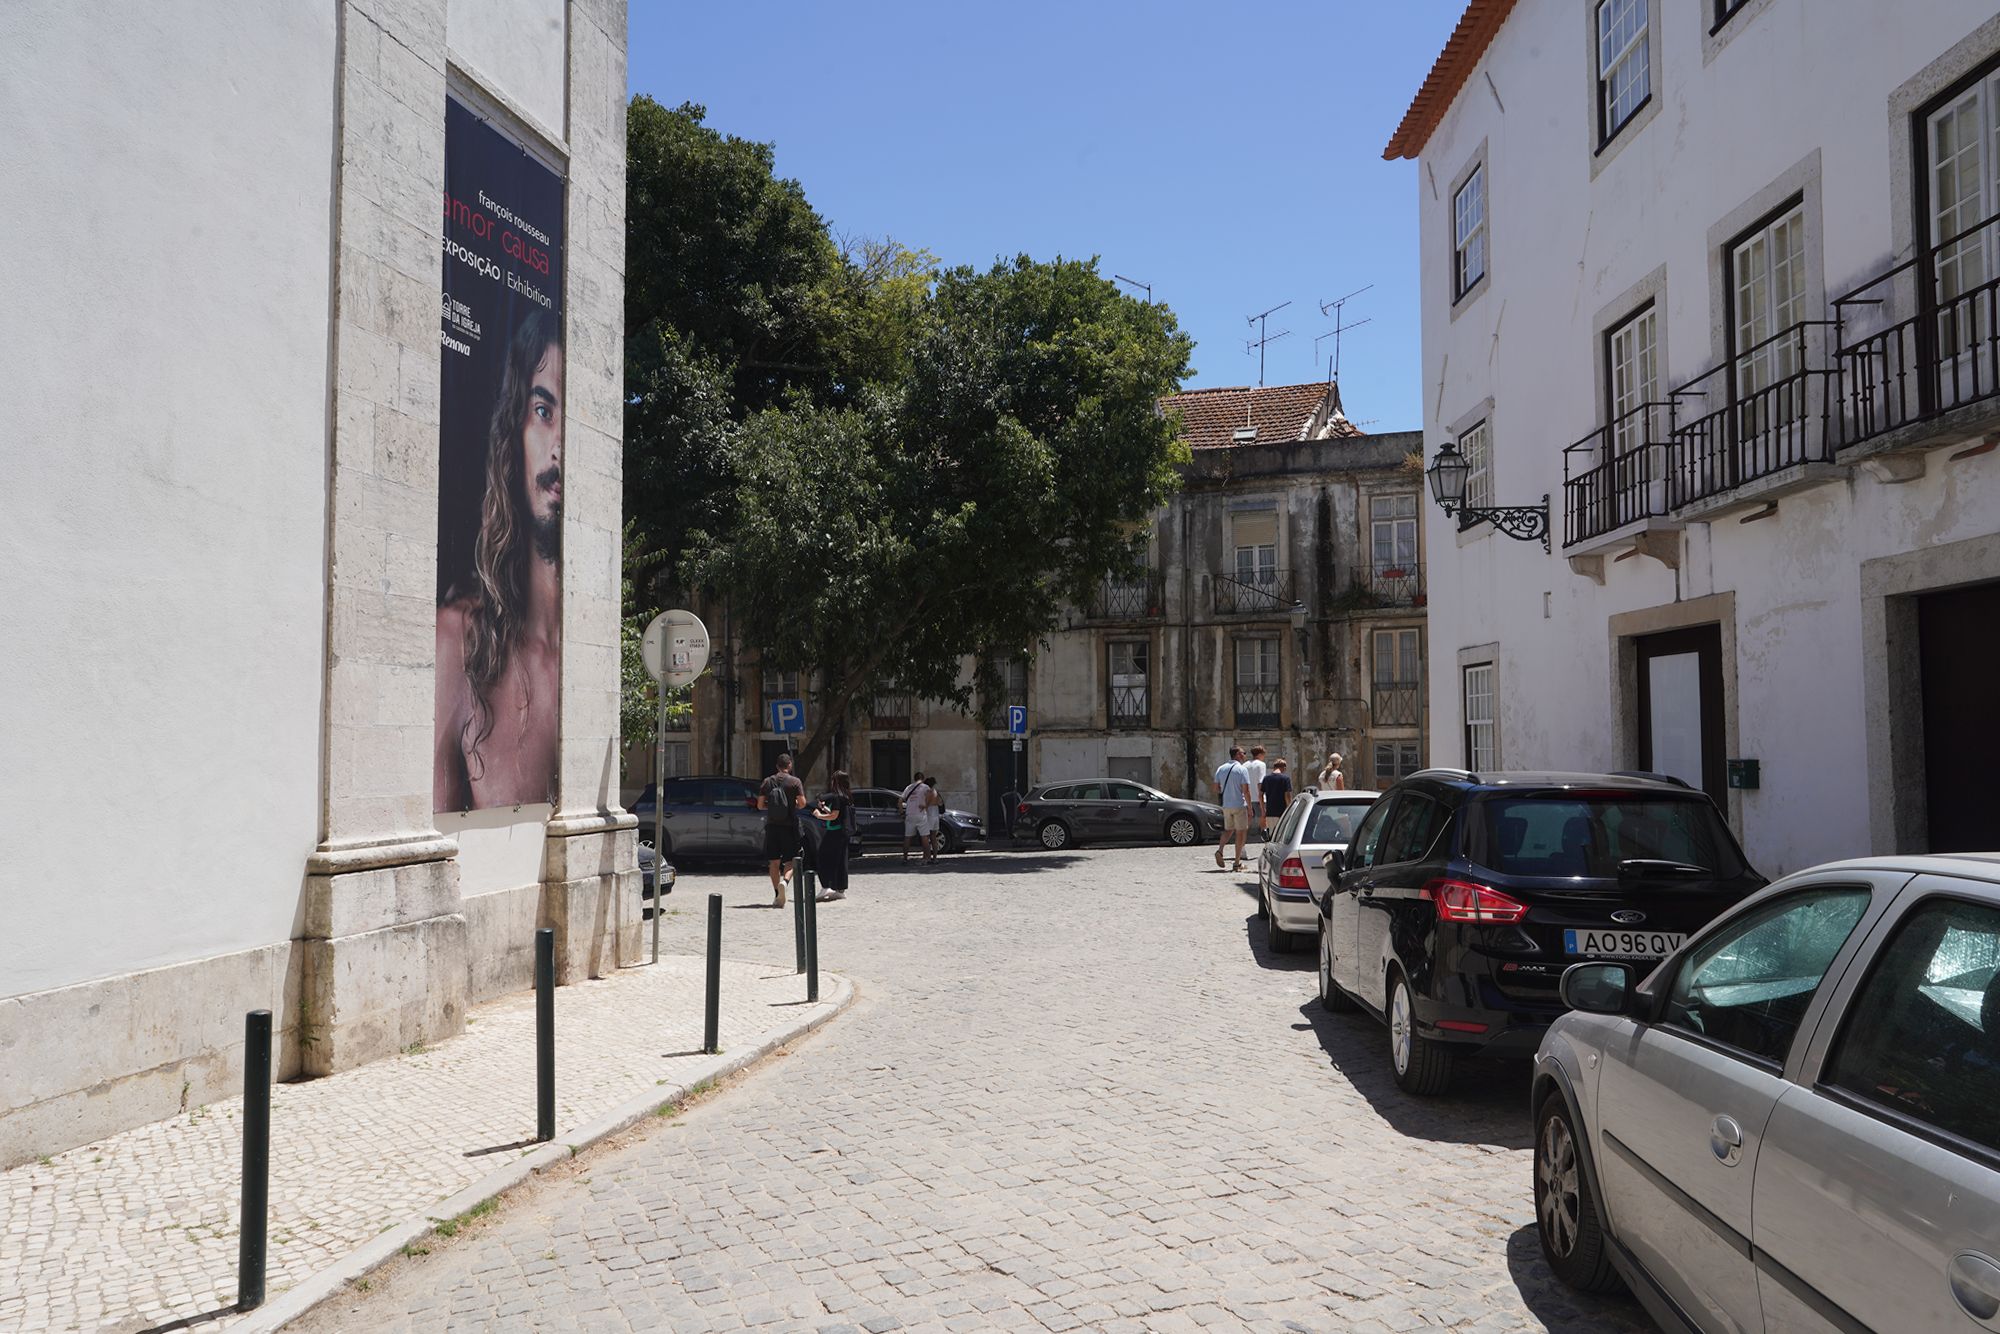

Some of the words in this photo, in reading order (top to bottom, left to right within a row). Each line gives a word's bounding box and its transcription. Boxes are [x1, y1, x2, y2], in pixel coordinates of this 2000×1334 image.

[443, 191, 495, 241] amor
[502, 231, 549, 275] causa
[478, 190, 513, 222] françois
[514, 216, 550, 246] rousseau
[507, 271, 552, 309] Exhibition
[441, 330, 470, 356] Renova
[777, 703, 798, 731] P
[1013, 709, 1023, 731] P
